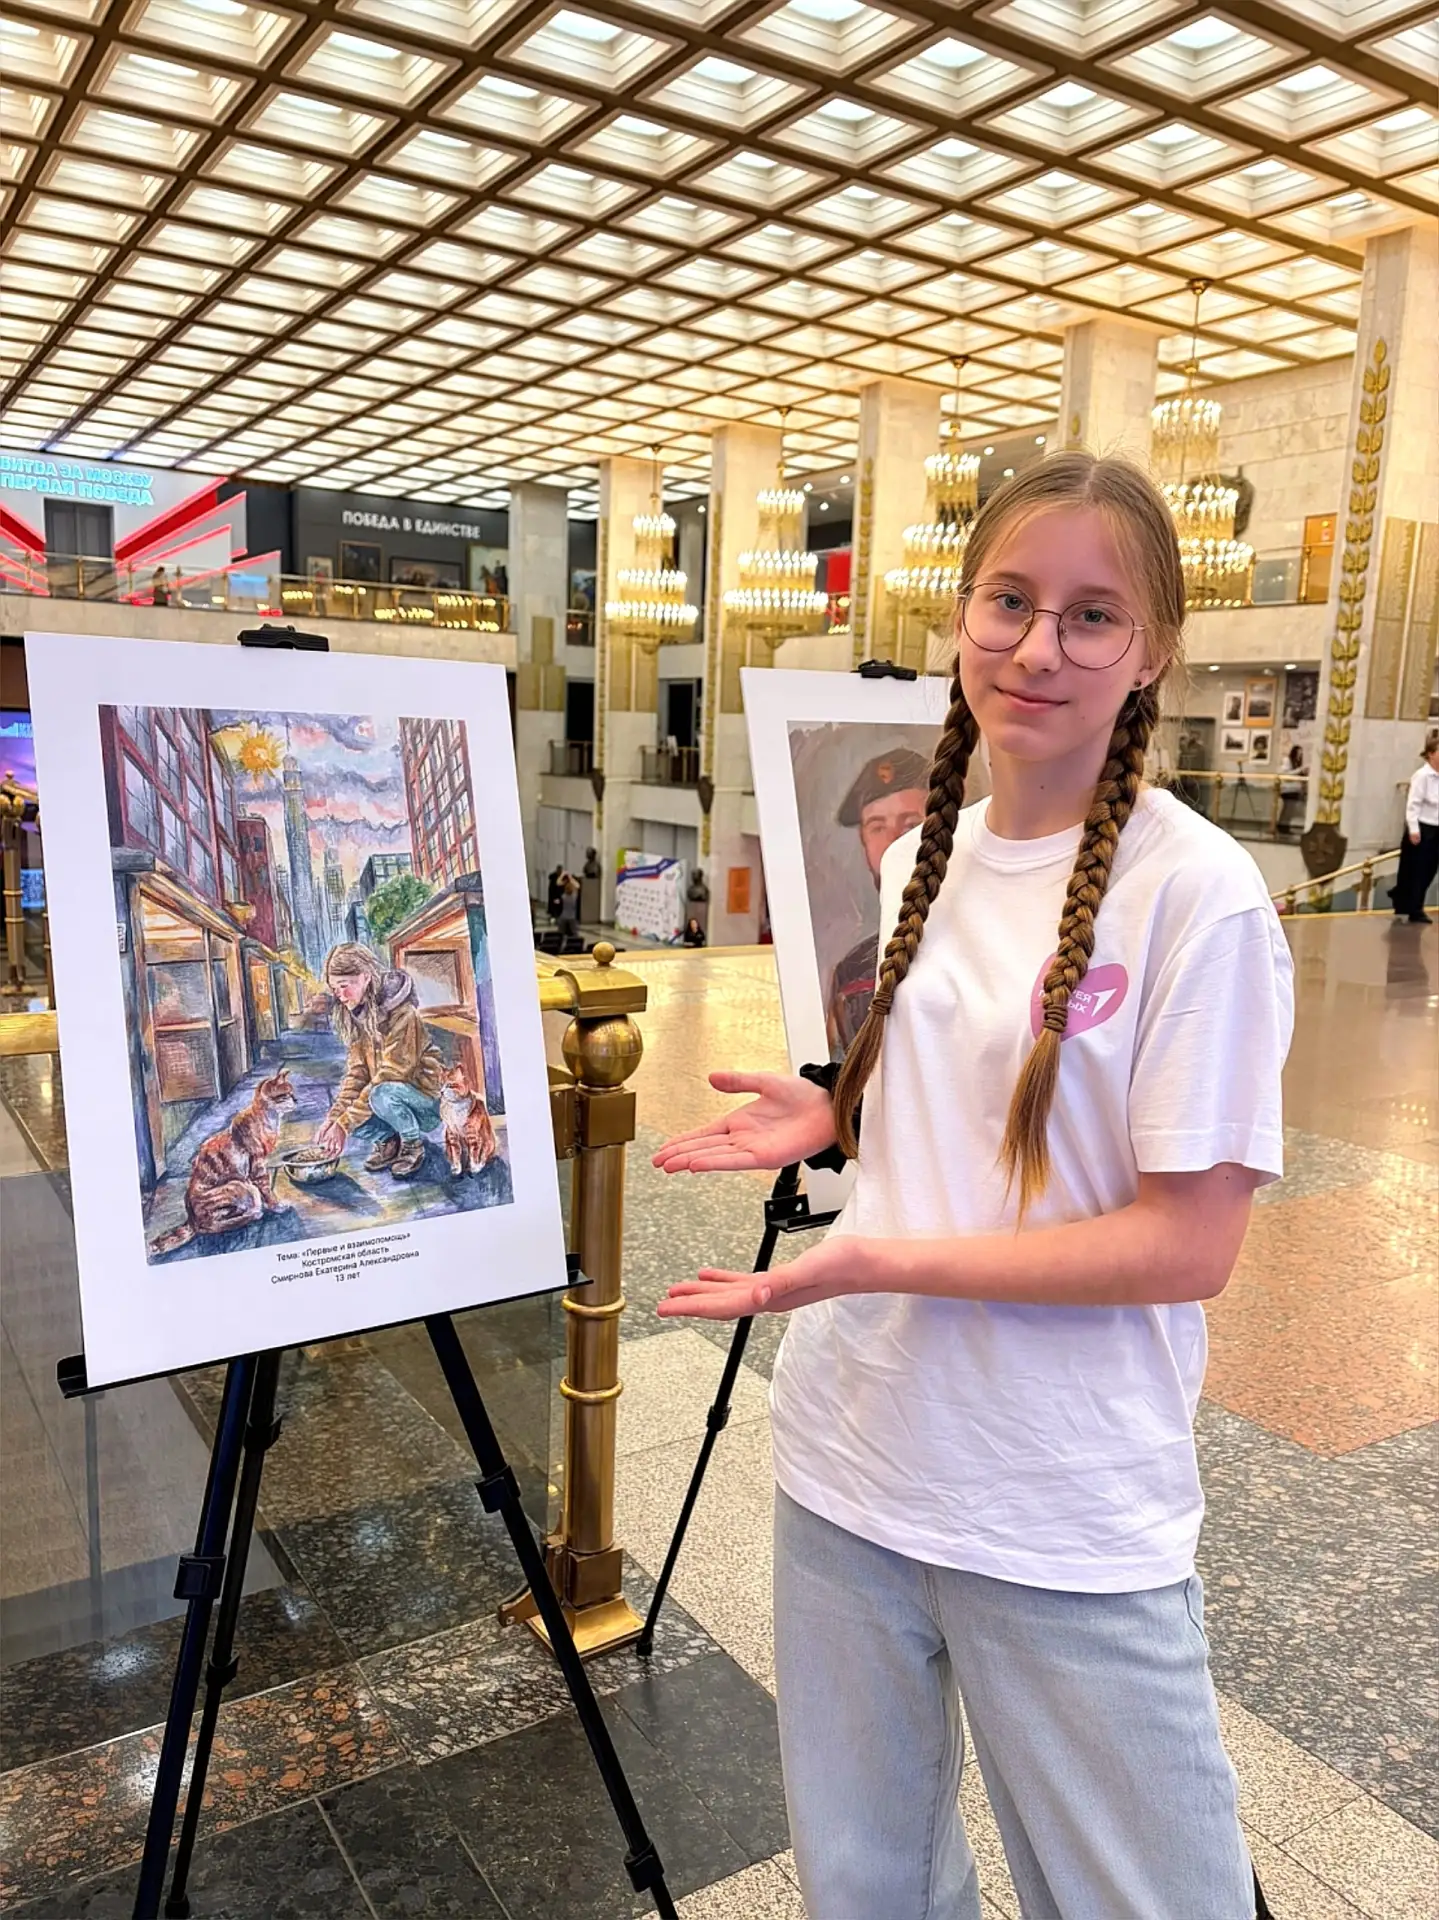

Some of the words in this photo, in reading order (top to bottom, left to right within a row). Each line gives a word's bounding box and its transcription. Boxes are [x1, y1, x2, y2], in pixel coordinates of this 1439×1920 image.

[0, 456, 57, 476] БИТВА
[60, 463, 83, 480] ЗА
[86, 467, 153, 489] МОСКВУ
[0, 472, 75, 495] ПЕРВАЯ
[78, 482, 154, 506] ПОБЕДА
[342, 510, 400, 530] ПОБЕДА
[403, 517, 412, 531] В
[415, 519, 480, 539] ЕДИНСТВЕ
[276, 1252, 299, 1262] Тема:
[302, 1245, 338, 1257] «Первые
[347, 1232, 411, 1250] взаимопомощь»
[302, 1252, 356, 1268] Костромская
[357, 1247, 389, 1258] область
[271, 1270, 313, 1284] Смирнова
[316, 1262, 357, 1276] Екатерина
[359, 1250, 420, 1267] Александровна
[335, 1273, 345, 1283] 13
[347, 1271, 360, 1281] лет
